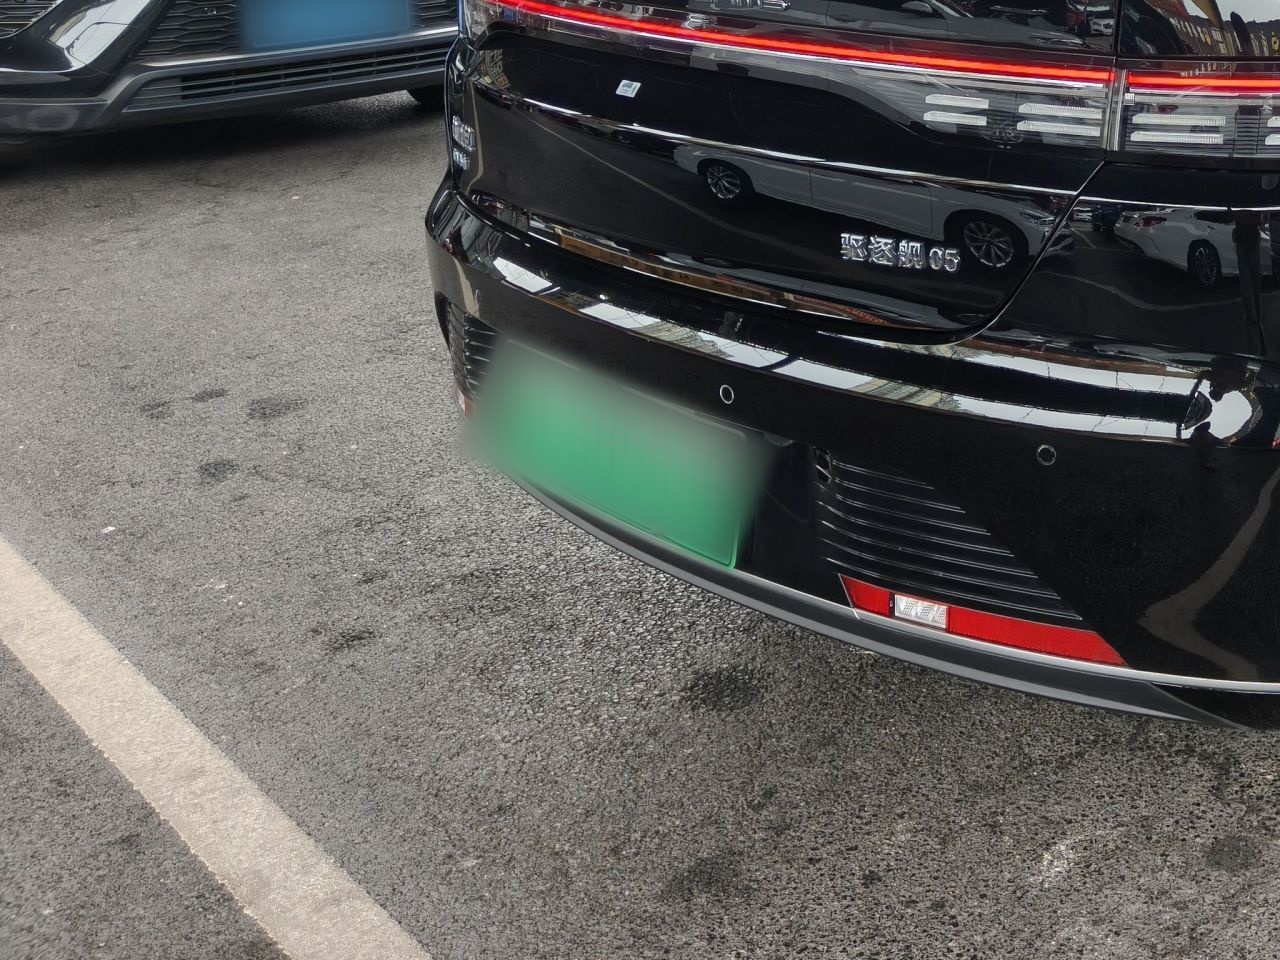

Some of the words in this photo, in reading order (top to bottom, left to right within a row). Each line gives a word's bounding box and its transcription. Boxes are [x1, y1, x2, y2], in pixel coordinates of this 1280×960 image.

[840, 233, 925, 270] 驱逐舰
[929, 247, 960, 272] 05
